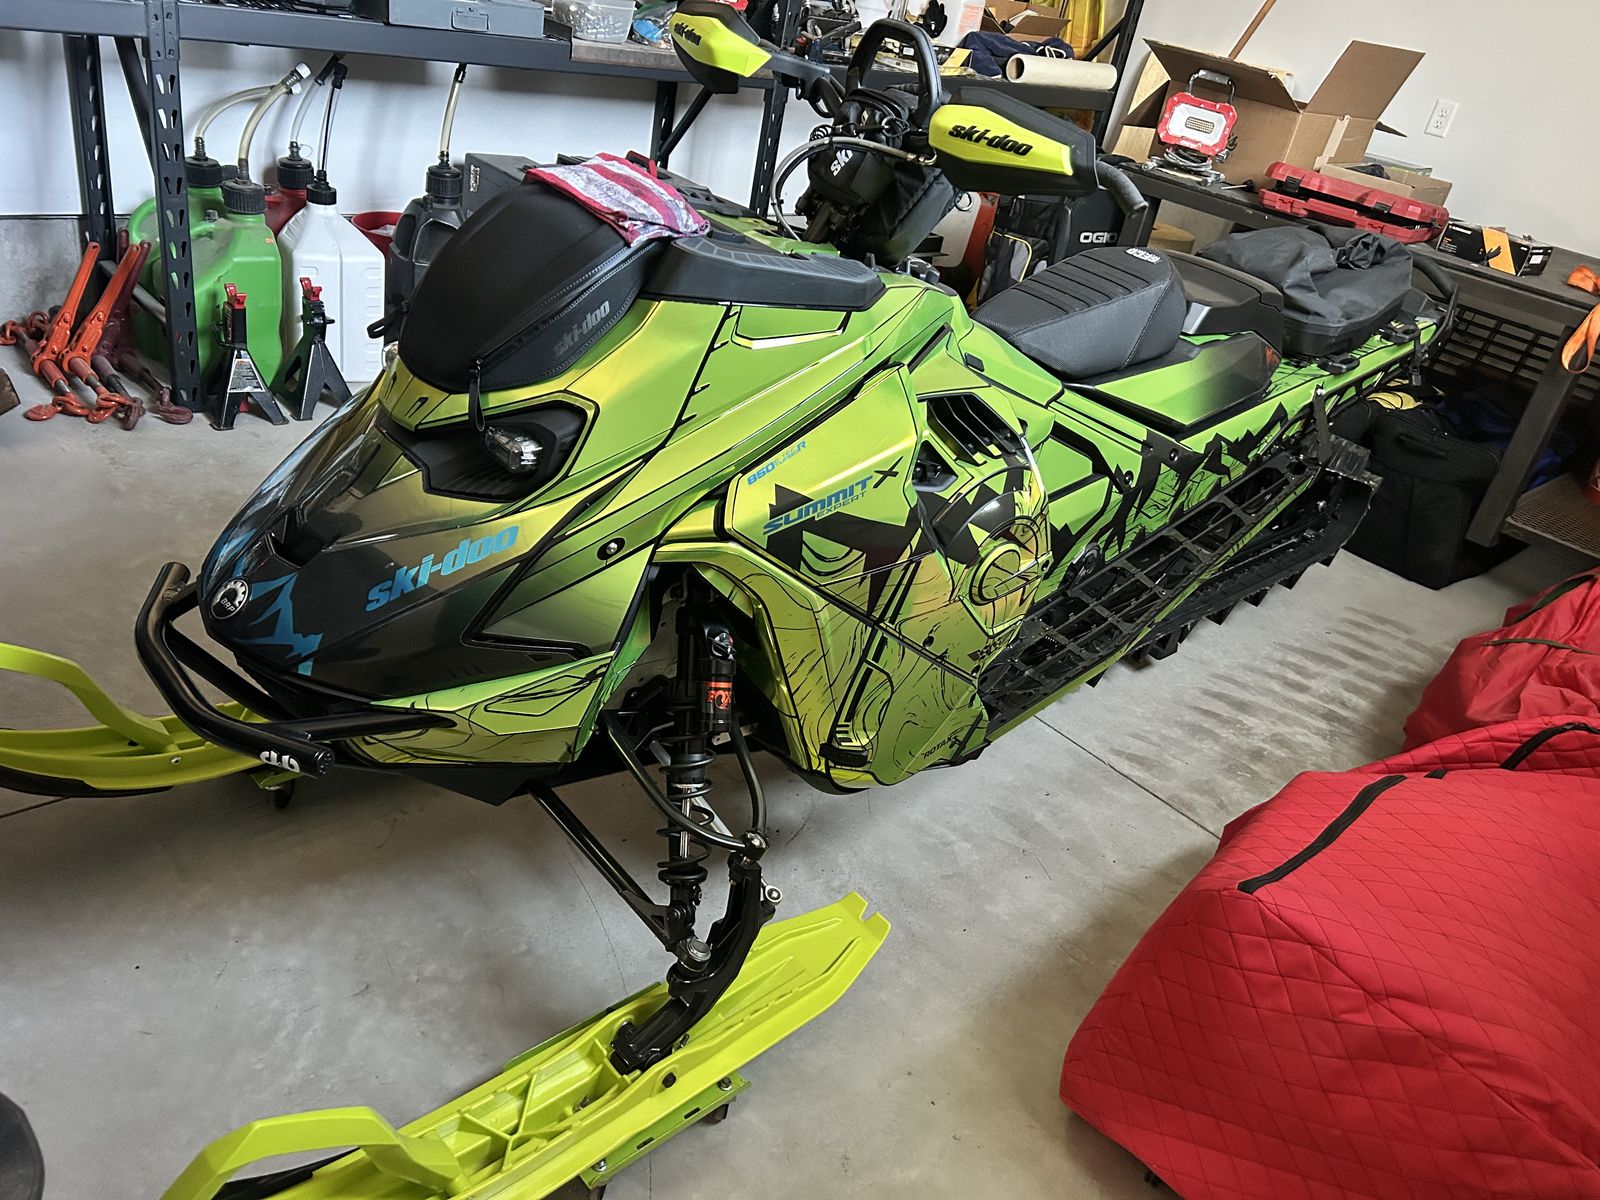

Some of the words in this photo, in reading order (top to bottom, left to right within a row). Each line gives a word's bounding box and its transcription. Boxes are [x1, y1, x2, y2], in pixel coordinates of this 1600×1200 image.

[948, 125, 1033, 156] ski-doo
[1080, 232, 1118, 244] OGIO
[554, 300, 611, 355] ski-doo
[747, 463, 776, 486] 850
[763, 475, 873, 536] SUMMIT
[872, 455, 904, 489] X
[816, 490, 867, 519] EXPERT
[365, 525, 519, 612] ski-doo
[220, 597, 236, 612] BRP
